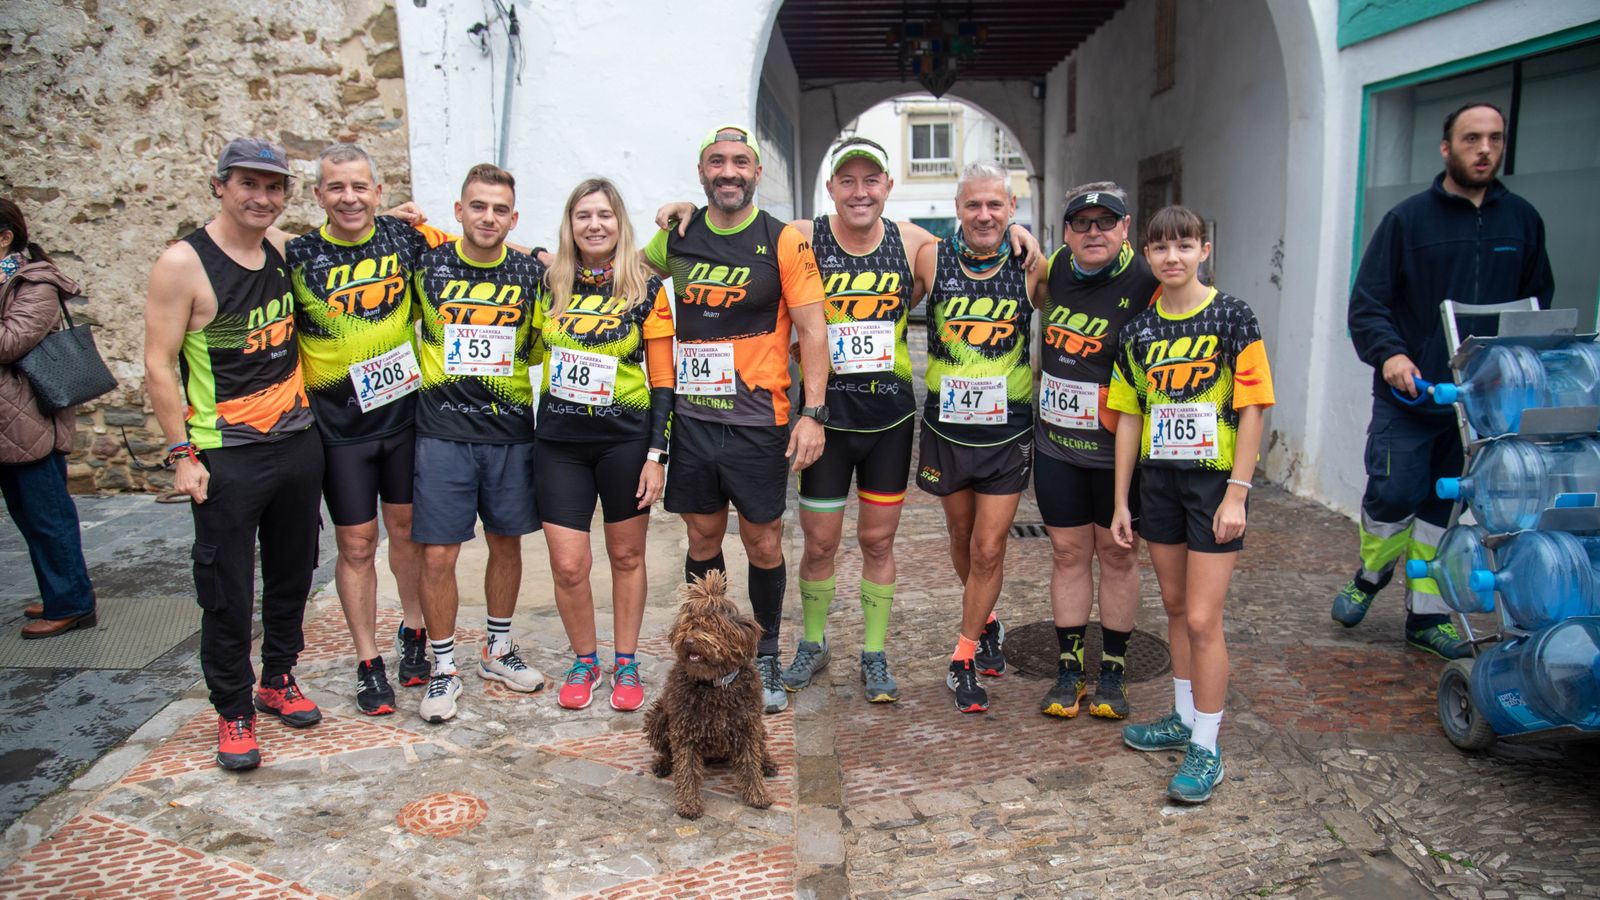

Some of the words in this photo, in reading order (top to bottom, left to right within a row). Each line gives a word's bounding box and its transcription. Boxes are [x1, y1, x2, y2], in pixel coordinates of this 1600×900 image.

[326, 252, 399, 290] non
[688, 262, 751, 285] non
[440, 280, 522, 304] non
[824, 272, 900, 293] non
[326, 276, 405, 319] STOP
[683, 284, 747, 308] STOP
[248, 291, 294, 329] non
[434, 303, 522, 326] STOP
[703, 310, 720, 318] team
[824, 295, 900, 320] STOP
[944, 296, 1018, 320] non
[839, 326, 859, 336] XIV
[1048, 305, 1109, 337] non
[457, 328, 478, 338] XIV
[940, 321, 1014, 346] STOP
[1045, 325, 1103, 359] STOP
[468, 339, 491, 358] 53
[684, 348, 698, 357] XIV
[851, 335, 874, 356] 85
[1145, 334, 1219, 365] non
[361, 360, 382, 374] XIV
[561, 352, 579, 364] XIV
[691, 358, 711, 378] 84
[1058, 354, 1077, 366] team
[370, 362, 405, 390] 208
[567, 364, 590, 386] 48
[952, 379, 971, 390] XIV
[1047, 378, 1062, 391] XIV
[1146, 361, 1217, 394] STOP
[827, 380, 900, 395] LGECIRAS
[961, 390, 983, 408] 47
[1050, 390, 1080, 413] 164
[1160, 408, 1177, 418] XIV
[1165, 418, 1196, 440] 165
